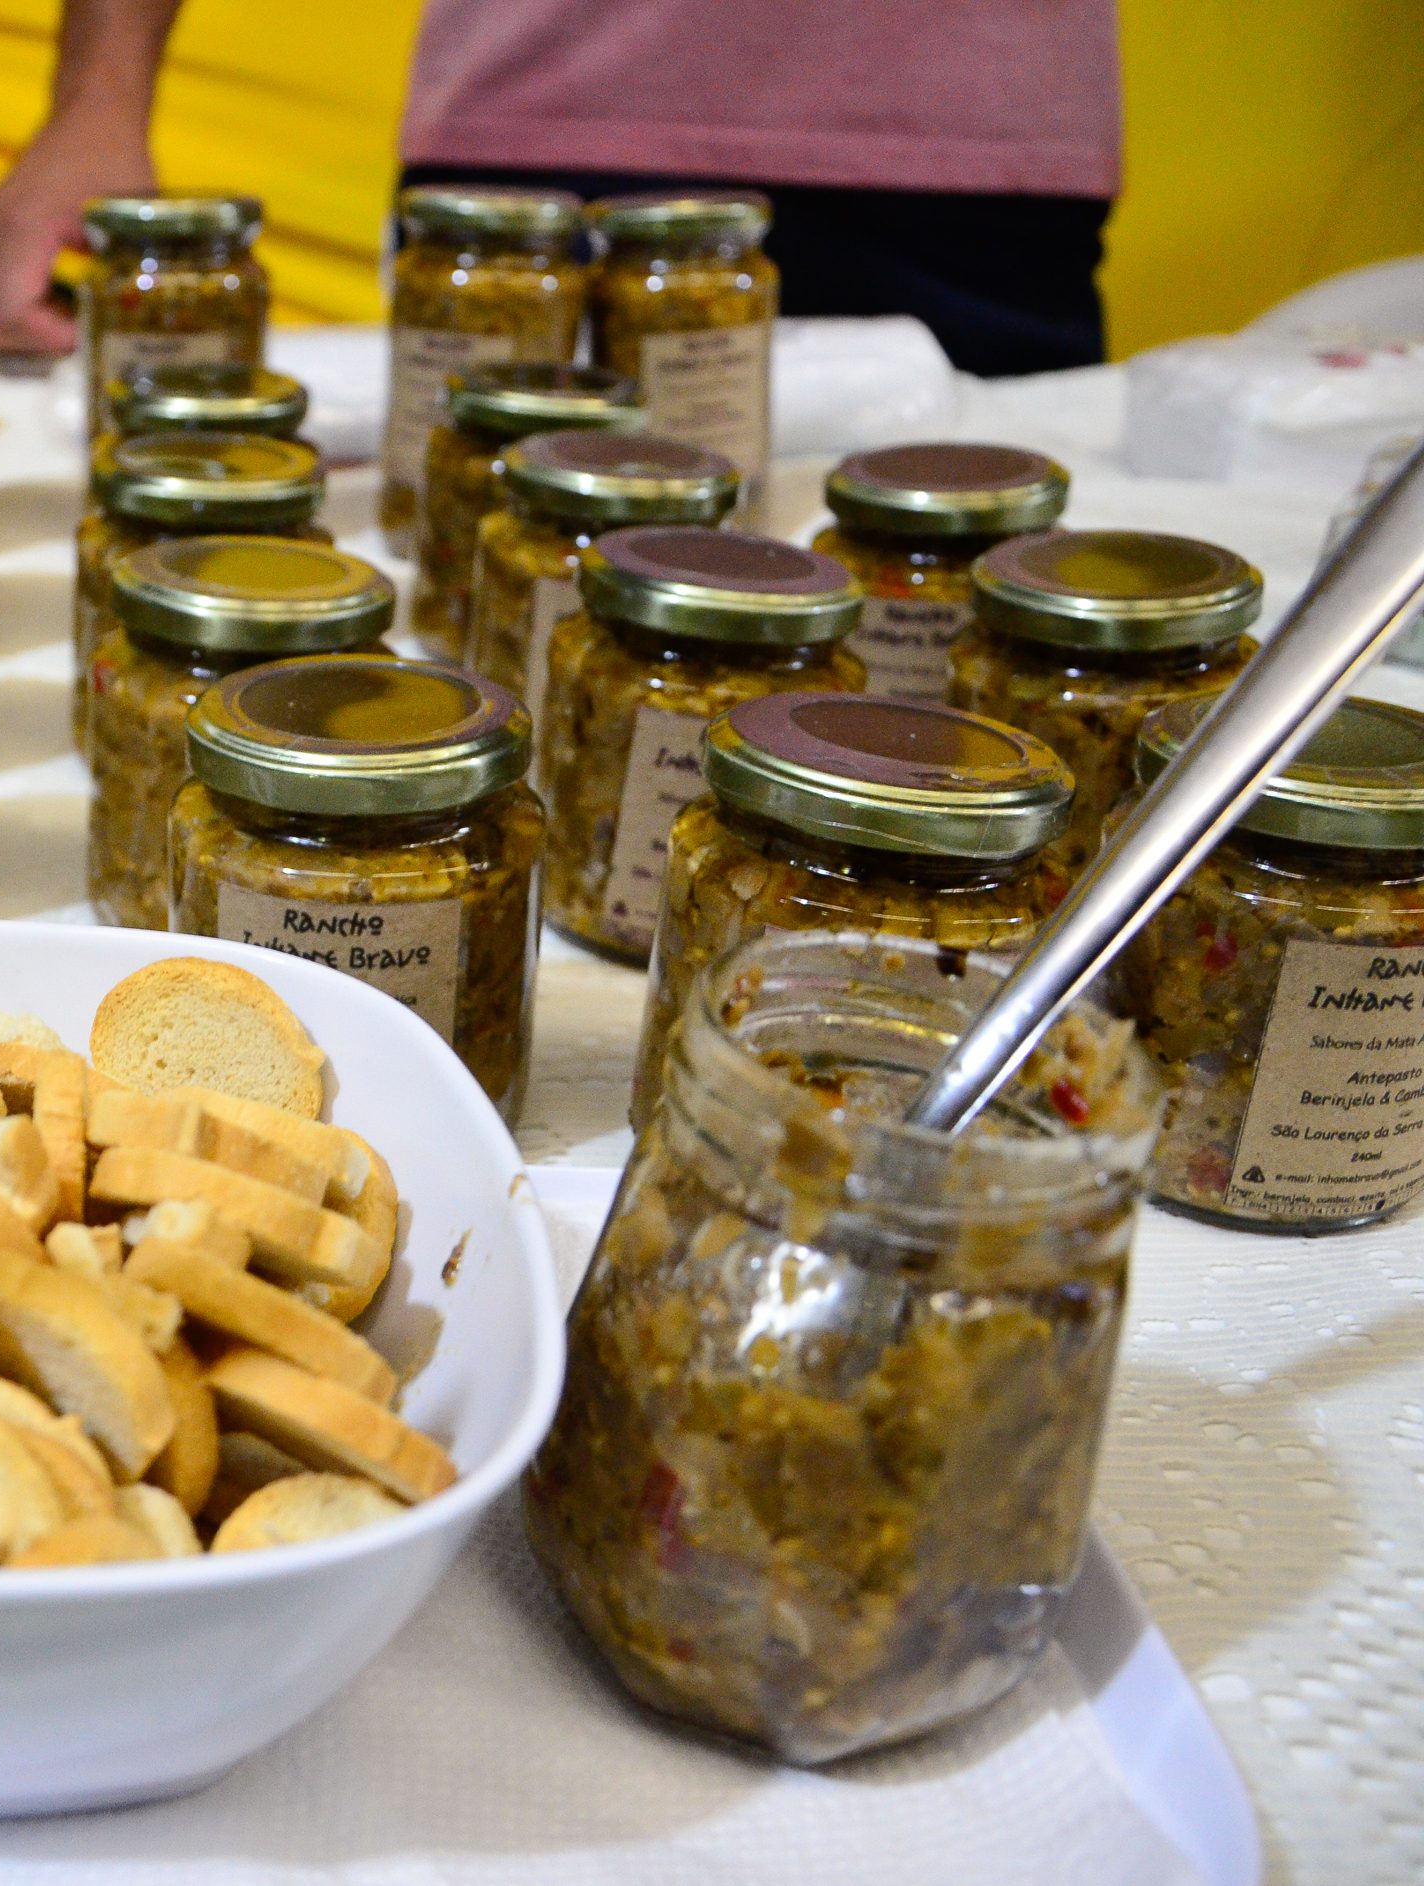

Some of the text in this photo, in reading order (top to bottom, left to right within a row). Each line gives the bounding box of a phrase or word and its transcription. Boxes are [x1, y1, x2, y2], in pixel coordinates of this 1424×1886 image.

[1310, 1034, 1416, 1050] Sabores da Mata
[1346, 1068, 1423, 1086] Antepasto
[1300, 1090, 1375, 1111] Berinjela
[1379, 1090, 1390, 1105] &
[1271, 1120, 1423, 1142] São Lourenço da Serra
[1350, 1151, 1382, 1163] 240ml
[1275, 1174, 1313, 1184] e-mail:
